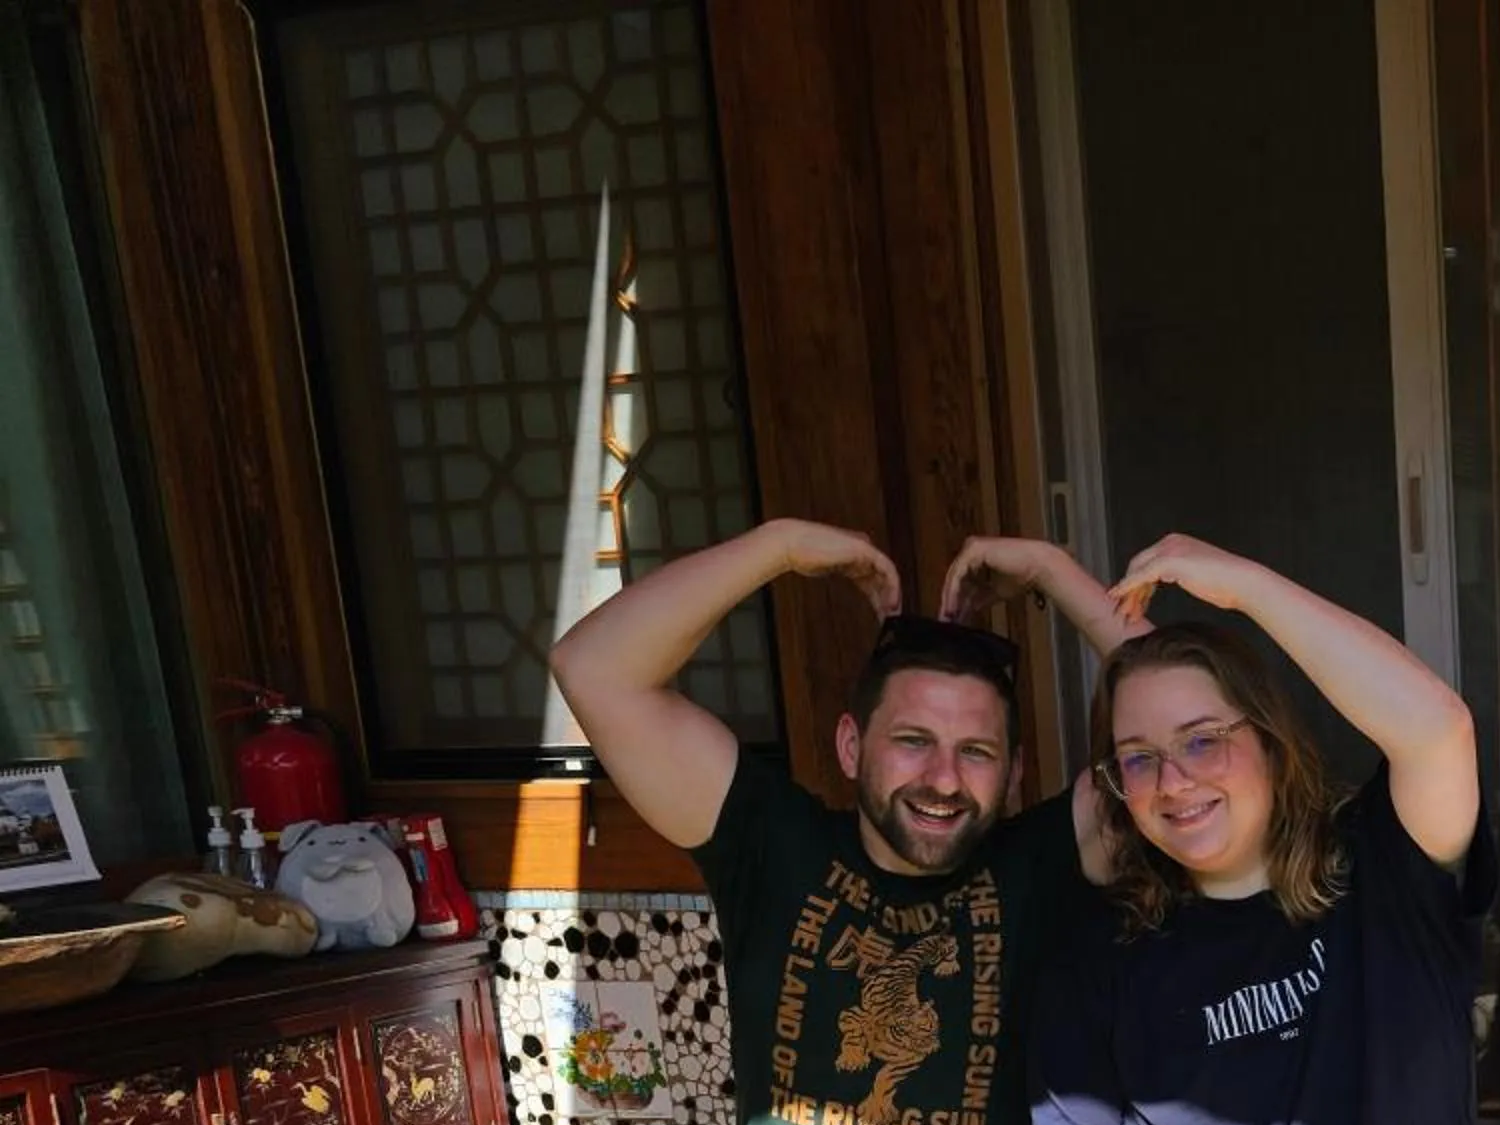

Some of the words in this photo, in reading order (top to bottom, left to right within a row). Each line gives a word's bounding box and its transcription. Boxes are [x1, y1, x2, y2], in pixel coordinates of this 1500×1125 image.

[791, 895, 839, 954] THE
[969, 867, 1000, 927] THE
[775, 953, 816, 1041] LAND
[972, 933, 1001, 1036] RISING
[772, 1044, 798, 1089] OF
[962, 1043, 998, 1112] SUN
